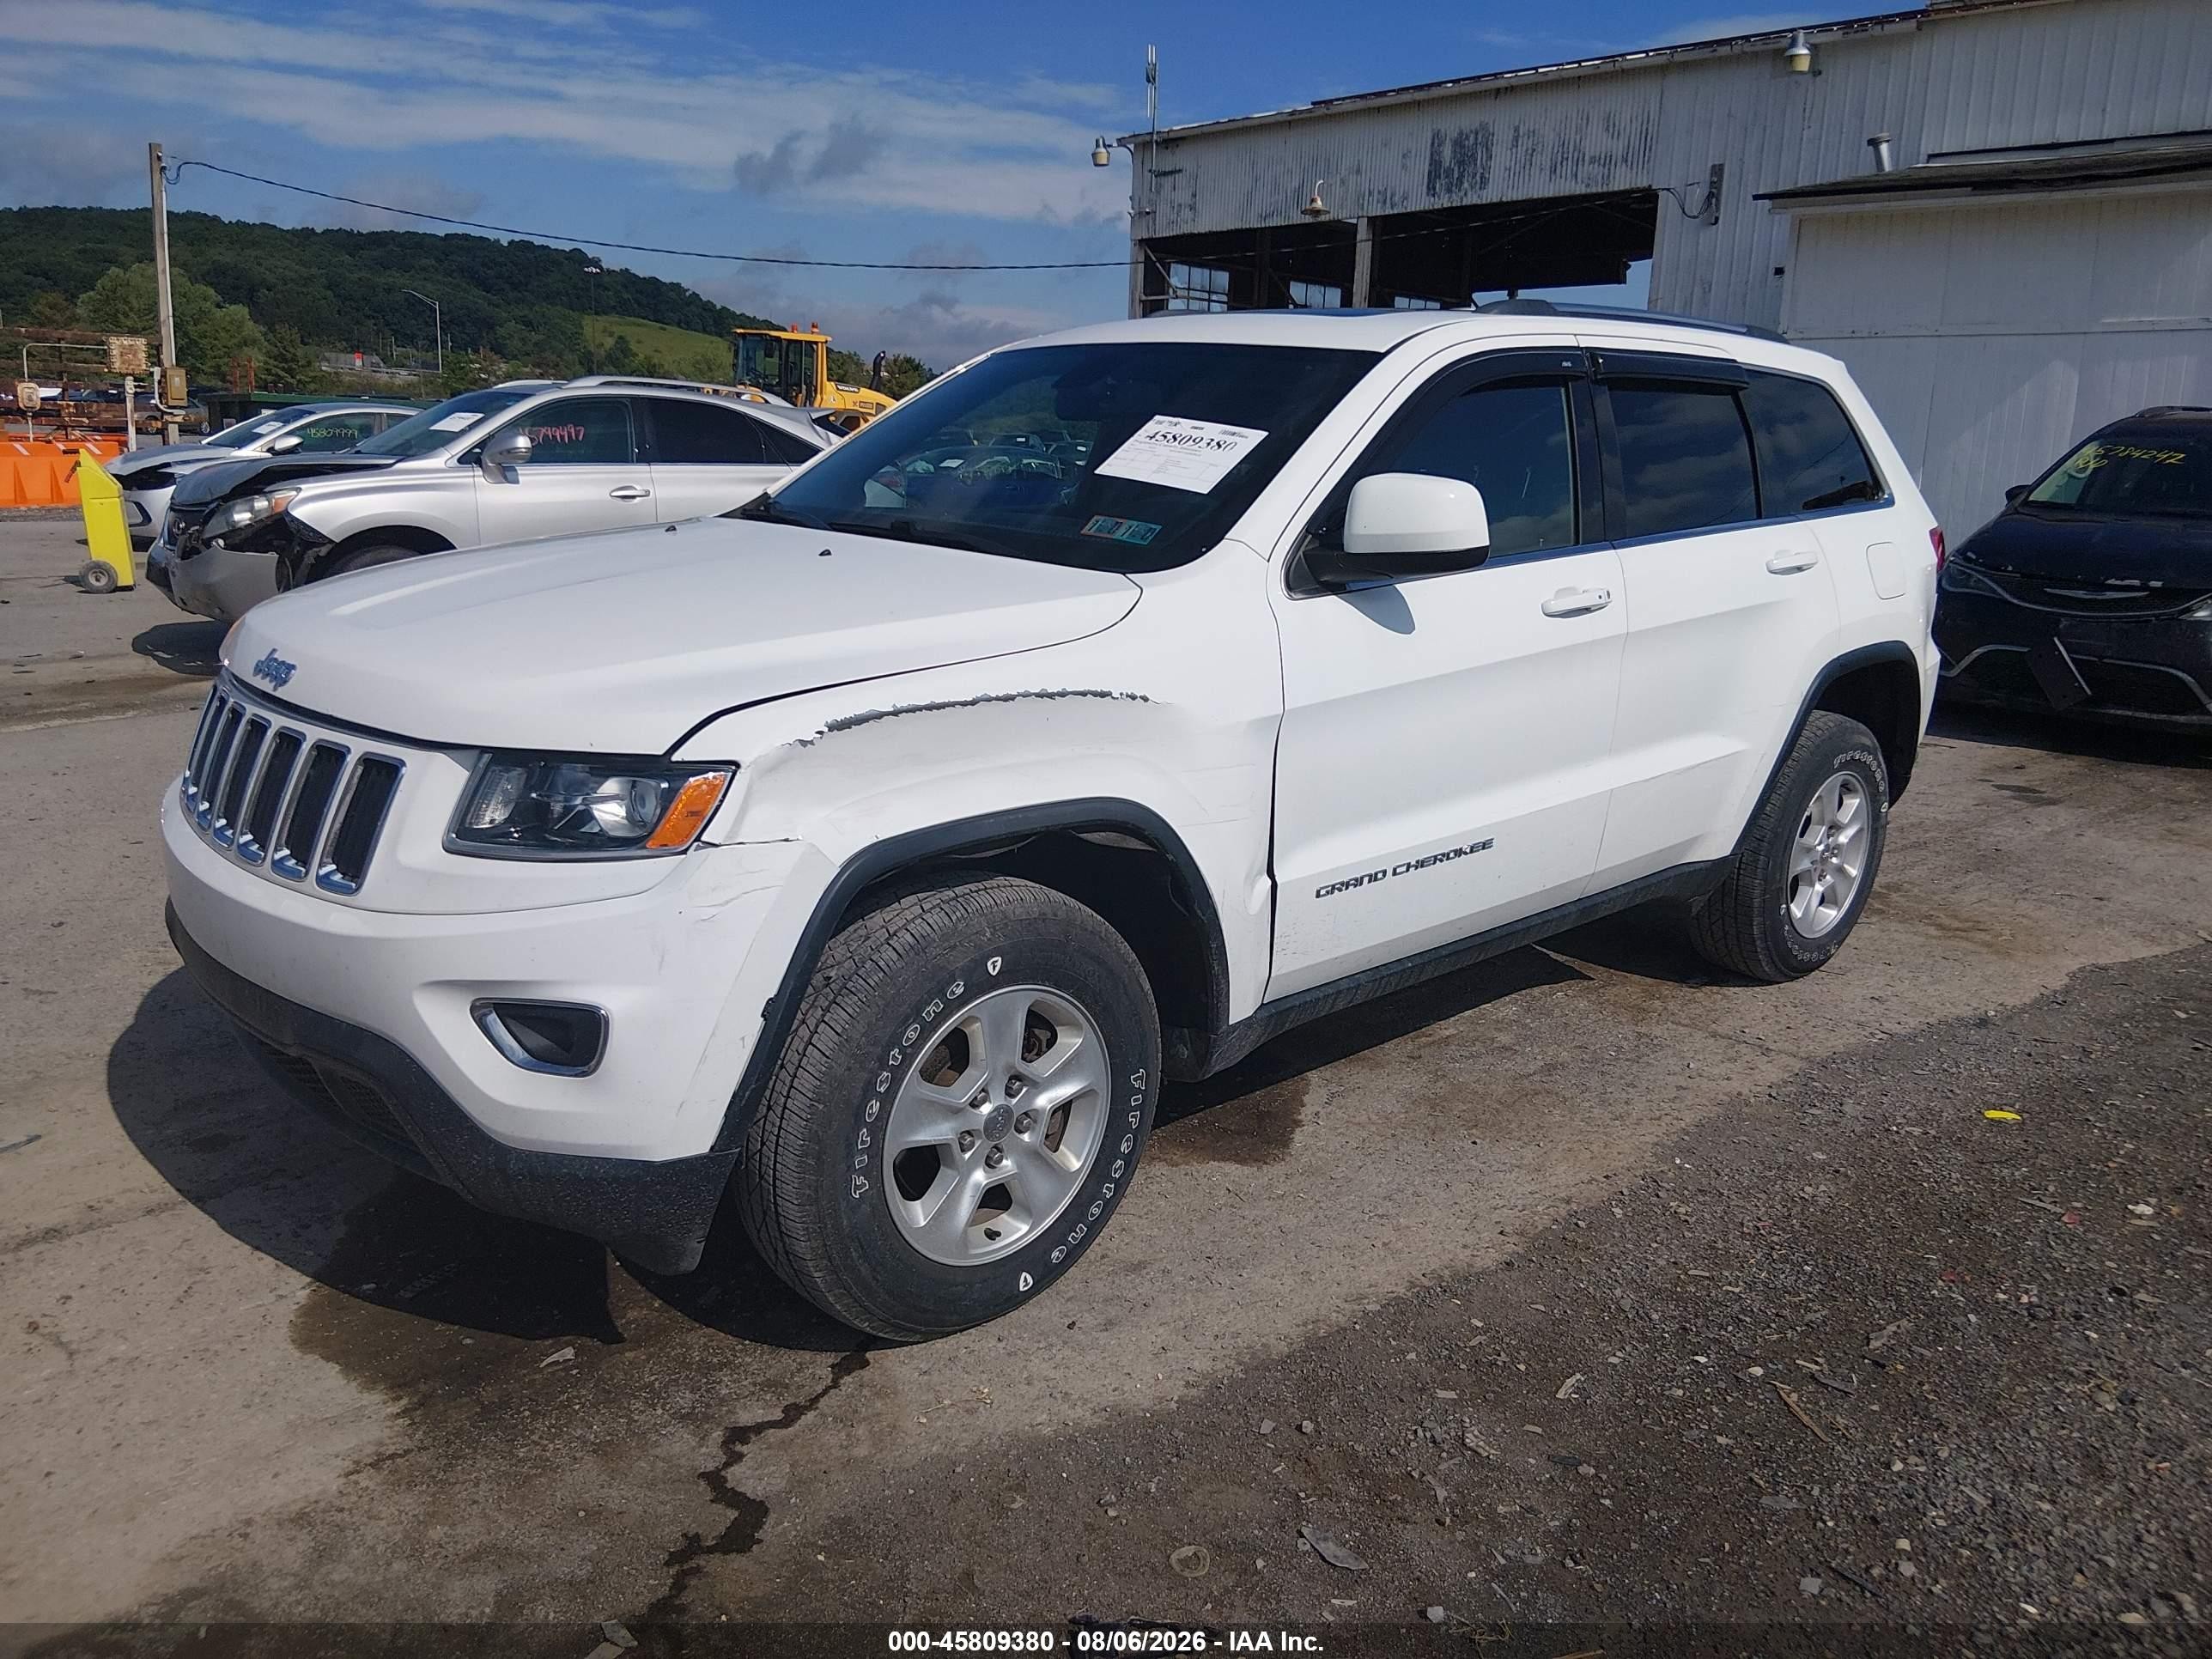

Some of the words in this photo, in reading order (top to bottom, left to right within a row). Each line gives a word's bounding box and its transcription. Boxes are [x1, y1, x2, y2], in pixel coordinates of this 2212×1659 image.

[1146, 430, 1237, 453] 45809380
[252, 647, 297, 692] Jeep
[1833, 750, 1885, 793] Firestone
[1316, 868, 1388, 899] GRAND
[1391, 837, 1495, 877] CHEROKEE
[851, 981, 965, 1198] Firestone
[1050, 1068, 1146, 1263] Firestone
